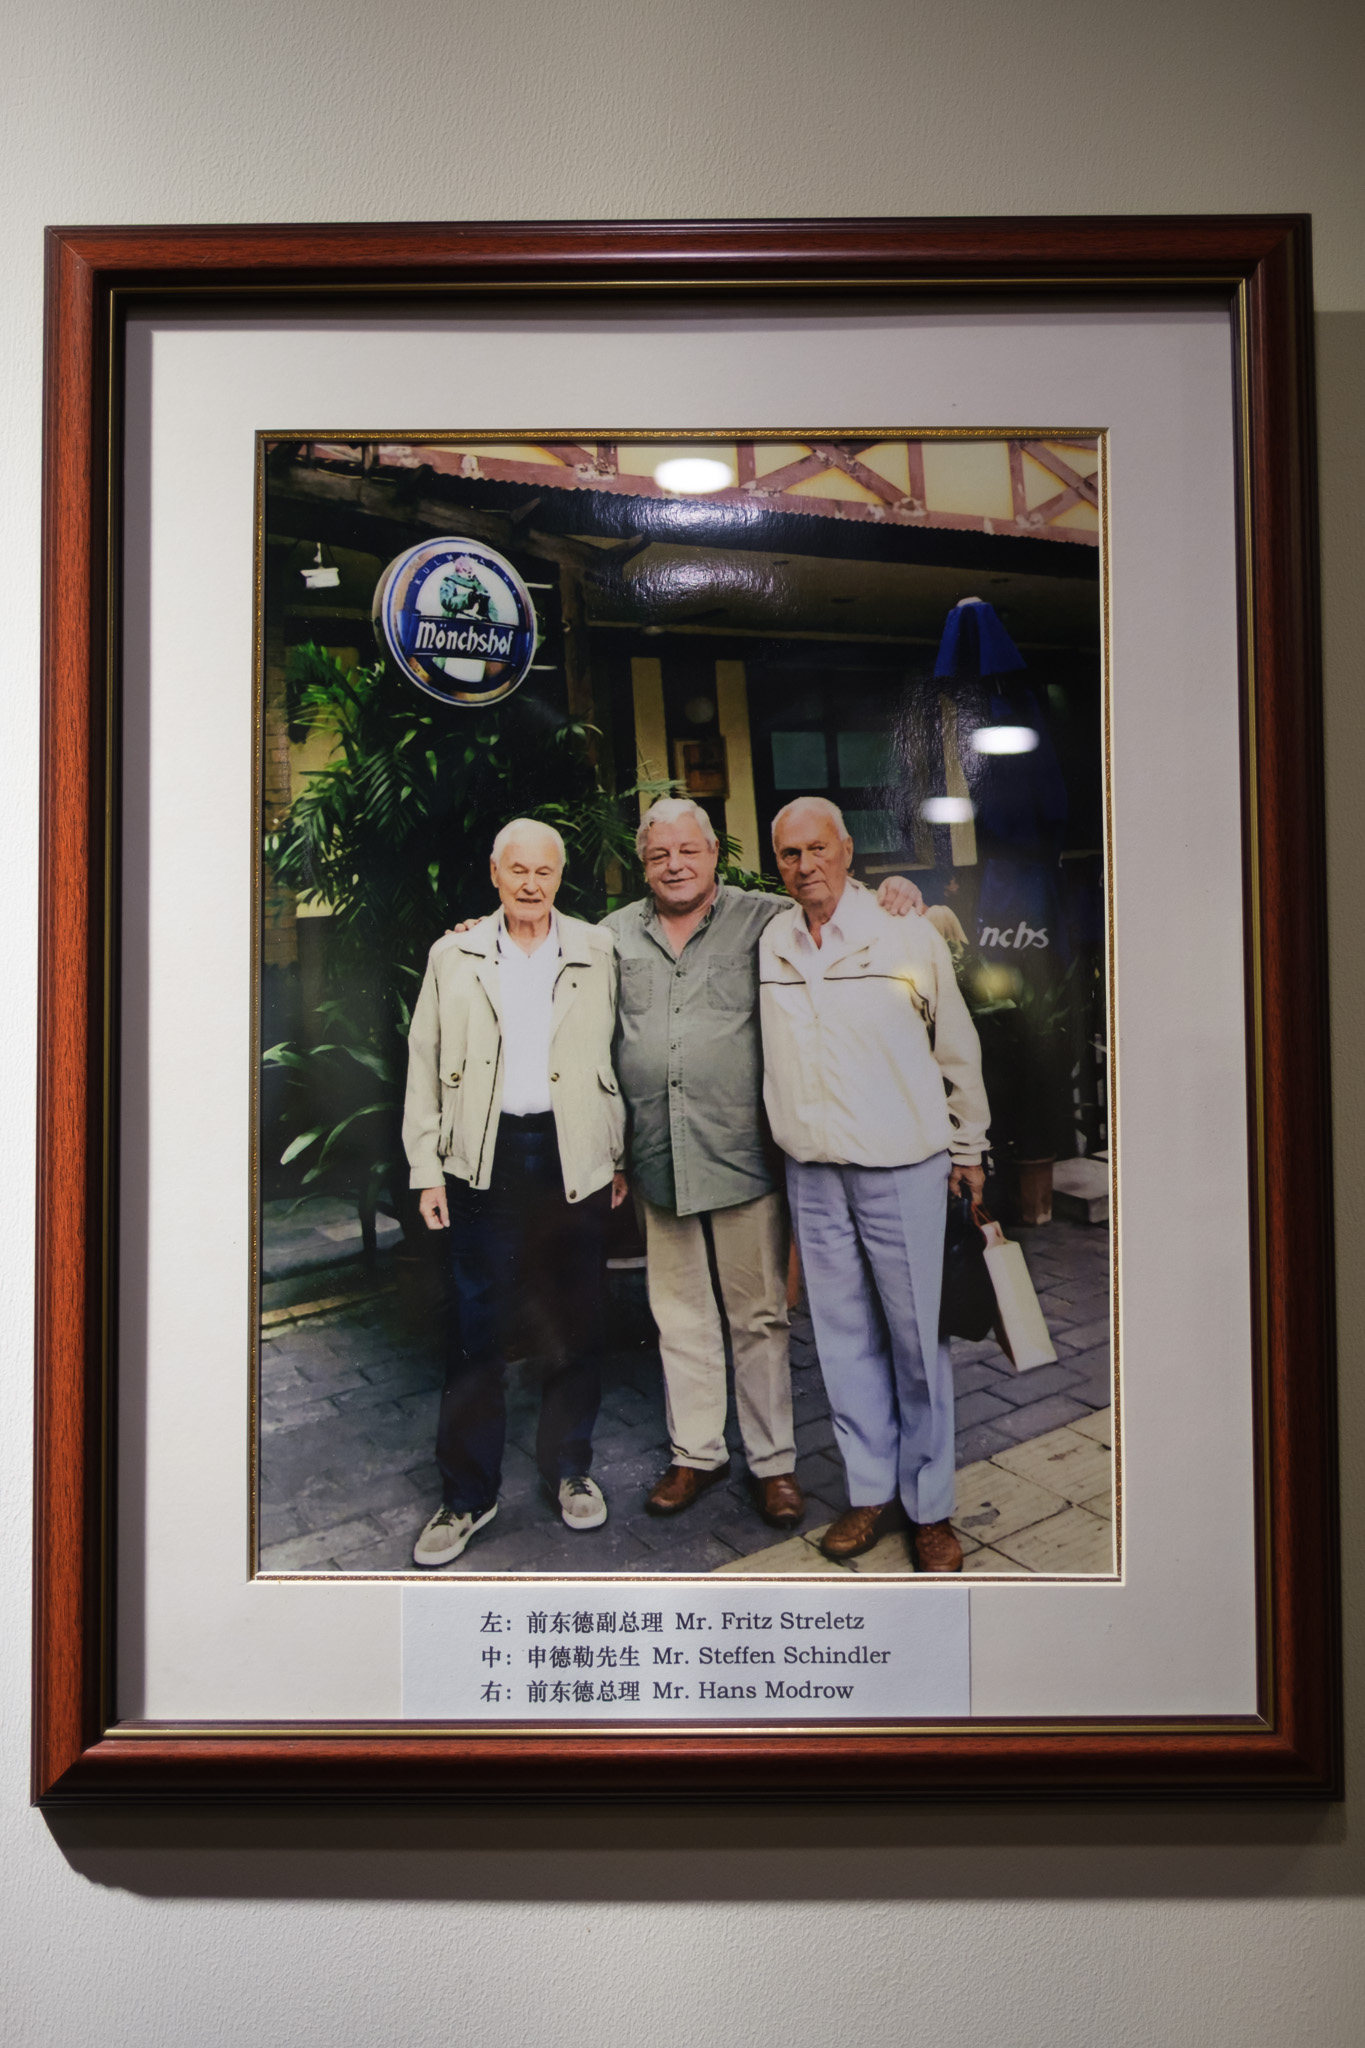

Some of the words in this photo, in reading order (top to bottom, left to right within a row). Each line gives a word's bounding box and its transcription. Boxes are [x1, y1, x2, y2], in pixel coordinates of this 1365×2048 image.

[414, 620, 514, 656] Mönchshof
[675, 1611, 713, 1631] Mr.
[721, 1611, 773, 1630] Fritz
[780, 1610, 865, 1630] Streletz
[652, 1646, 690, 1665] Mr.
[699, 1645, 777, 1665] Steffen
[784, 1645, 892, 1665] Schindler
[652, 1681, 690, 1700] Mr.
[698, 1680, 758, 1700] Hans
[765, 1679, 855, 1700] Modrow
